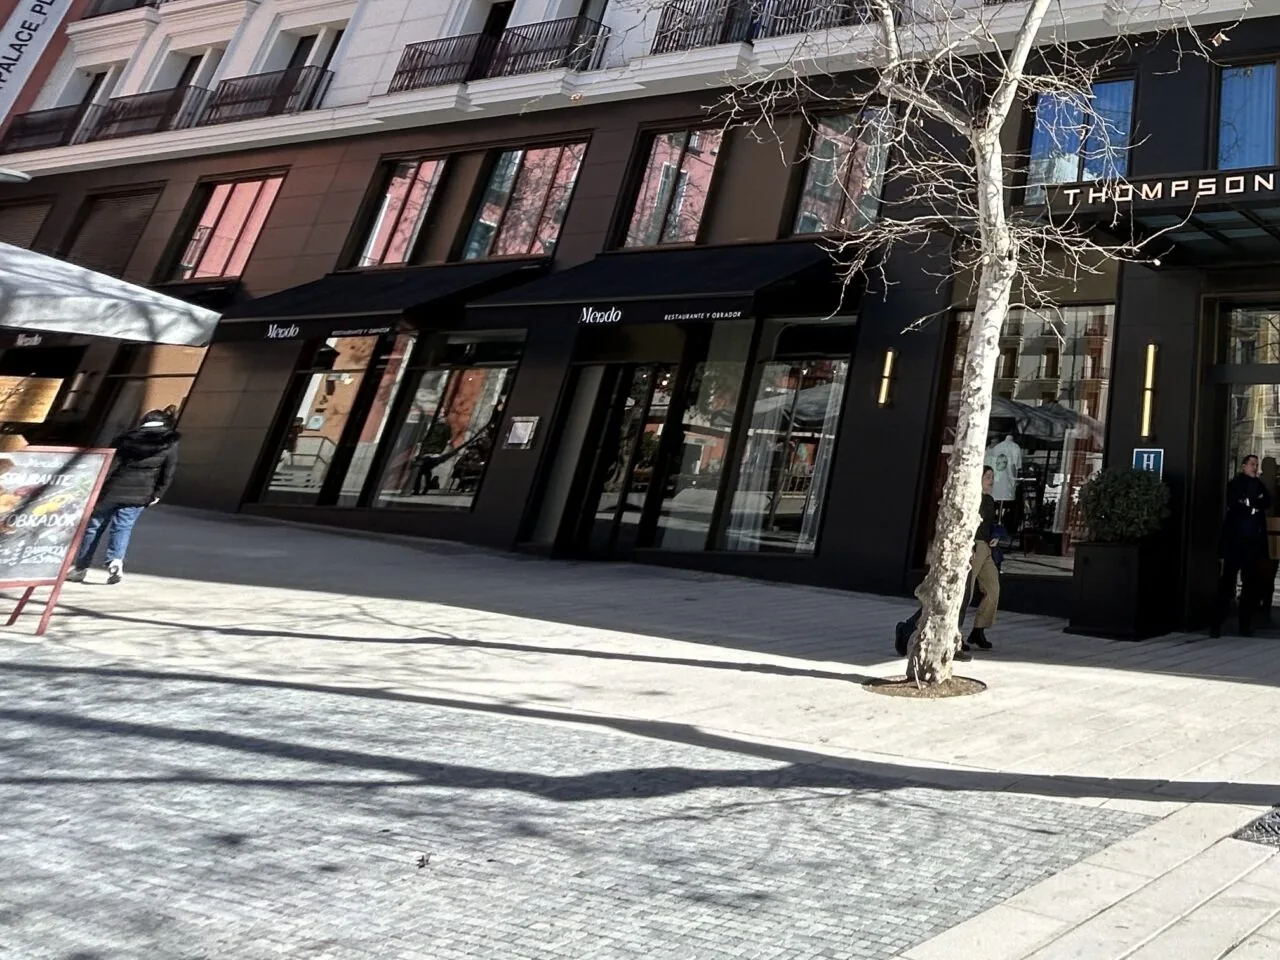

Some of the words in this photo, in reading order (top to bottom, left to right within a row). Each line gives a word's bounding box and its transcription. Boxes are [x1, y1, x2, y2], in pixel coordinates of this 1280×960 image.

[1063, 173, 1275, 206] THOMPSON
[577, 306, 622, 323] Mendo
[664, 312, 705, 321] RESTAURANTE
[711, 311, 742, 319] OBRADOR
[265, 323, 300, 338] Mendo
[1142, 453, 1155, 471] H
